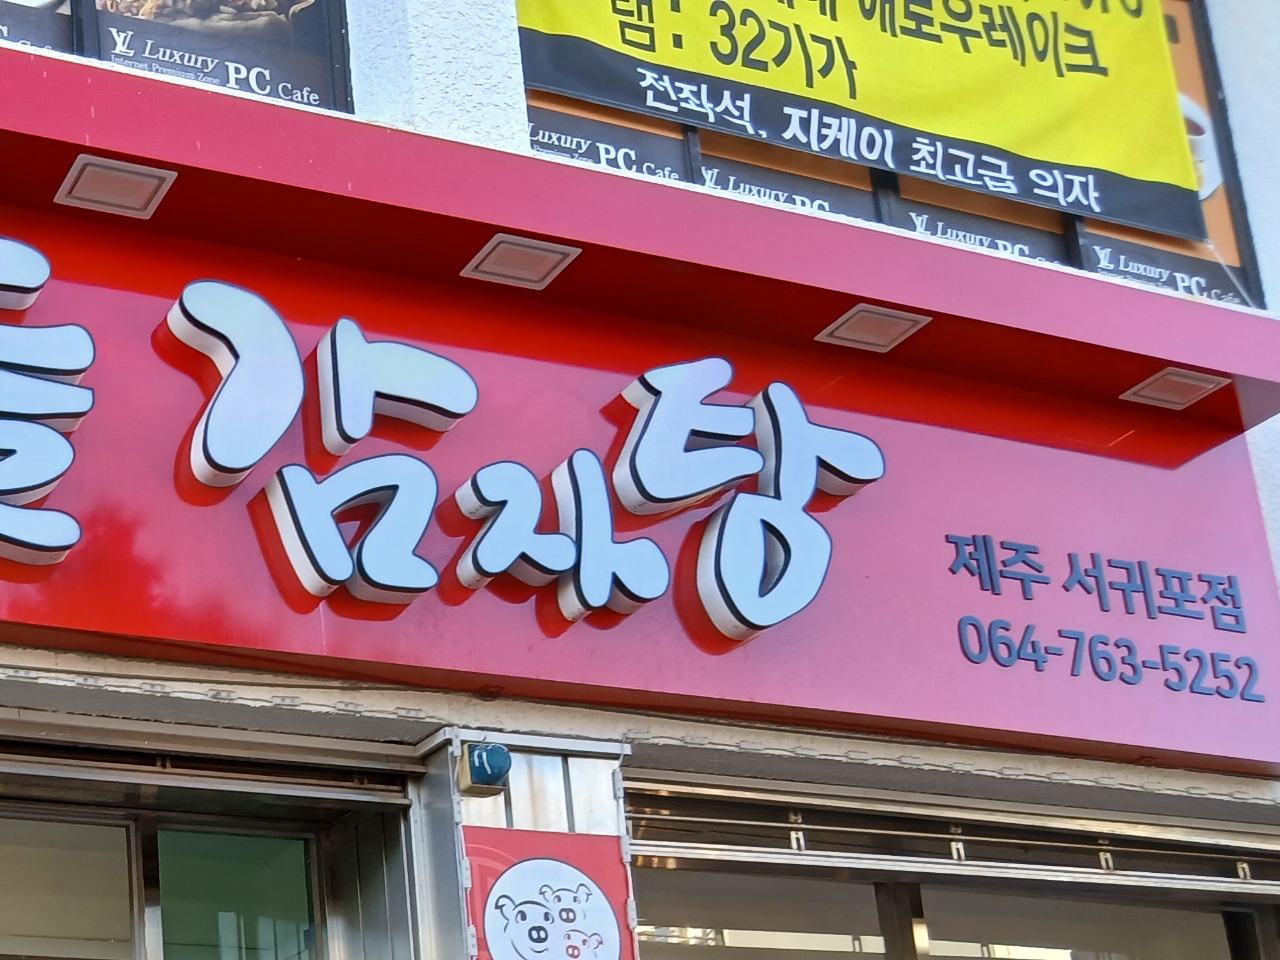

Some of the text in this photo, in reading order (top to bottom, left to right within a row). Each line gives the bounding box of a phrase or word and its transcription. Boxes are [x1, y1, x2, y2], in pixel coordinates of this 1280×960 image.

[141, 40, 220, 73] Luxury
[224, 61, 271, 95] PC
[277, 83, 321, 105] Cafe
[528, 122, 592, 153] Luxury
[596, 142, 638, 173] PC
[782, 106, 896, 169] 지케이
[910, 136, 1018, 195] 최고급
[1028, 167, 1101, 212] 의자
[728, 175, 789, 203] Luxury
[936, 221, 992, 248] Luxury
[1118, 255, 1172, 282] Luxury
[1173, 272, 1208, 299] PC
[169, 278, 886, 638] 감자탕
[945, 533, 1247, 634] 제주 서귀포점
[957, 615, 1266, 703] 064-763-5252
